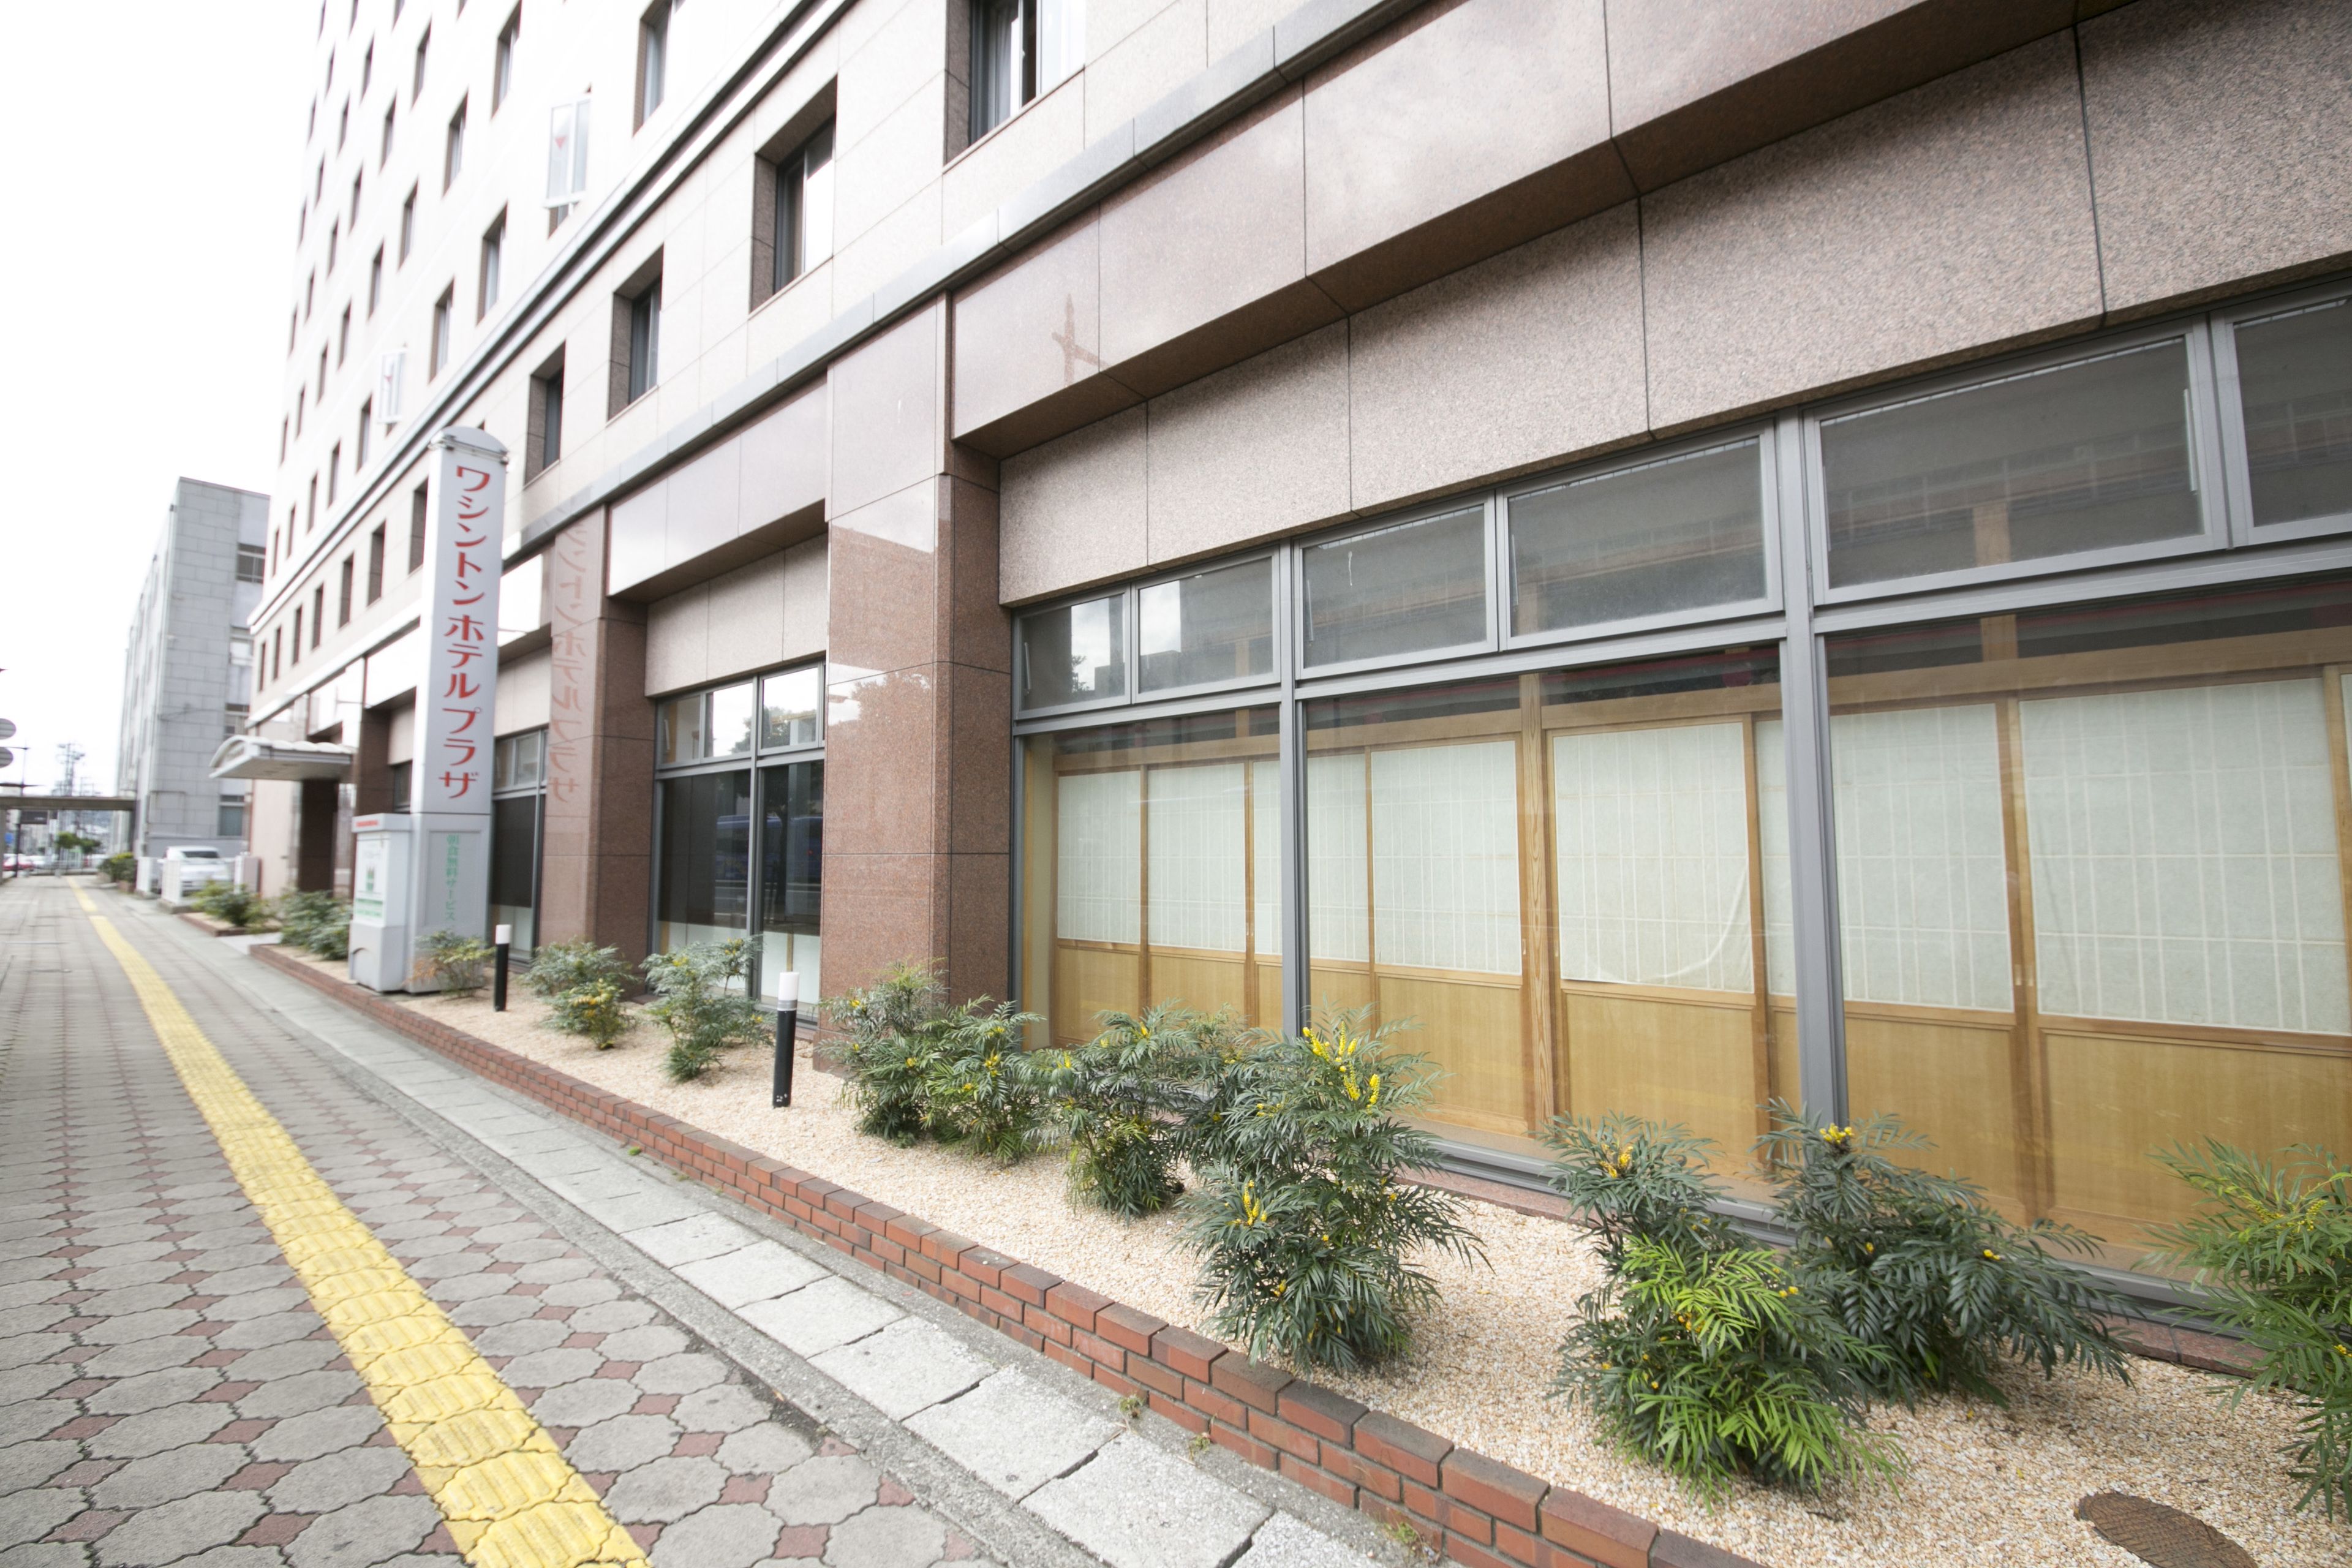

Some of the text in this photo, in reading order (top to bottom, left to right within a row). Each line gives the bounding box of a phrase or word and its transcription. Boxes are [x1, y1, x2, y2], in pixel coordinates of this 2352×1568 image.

[438, 464, 491, 799] ワシントンホテルプラザ
